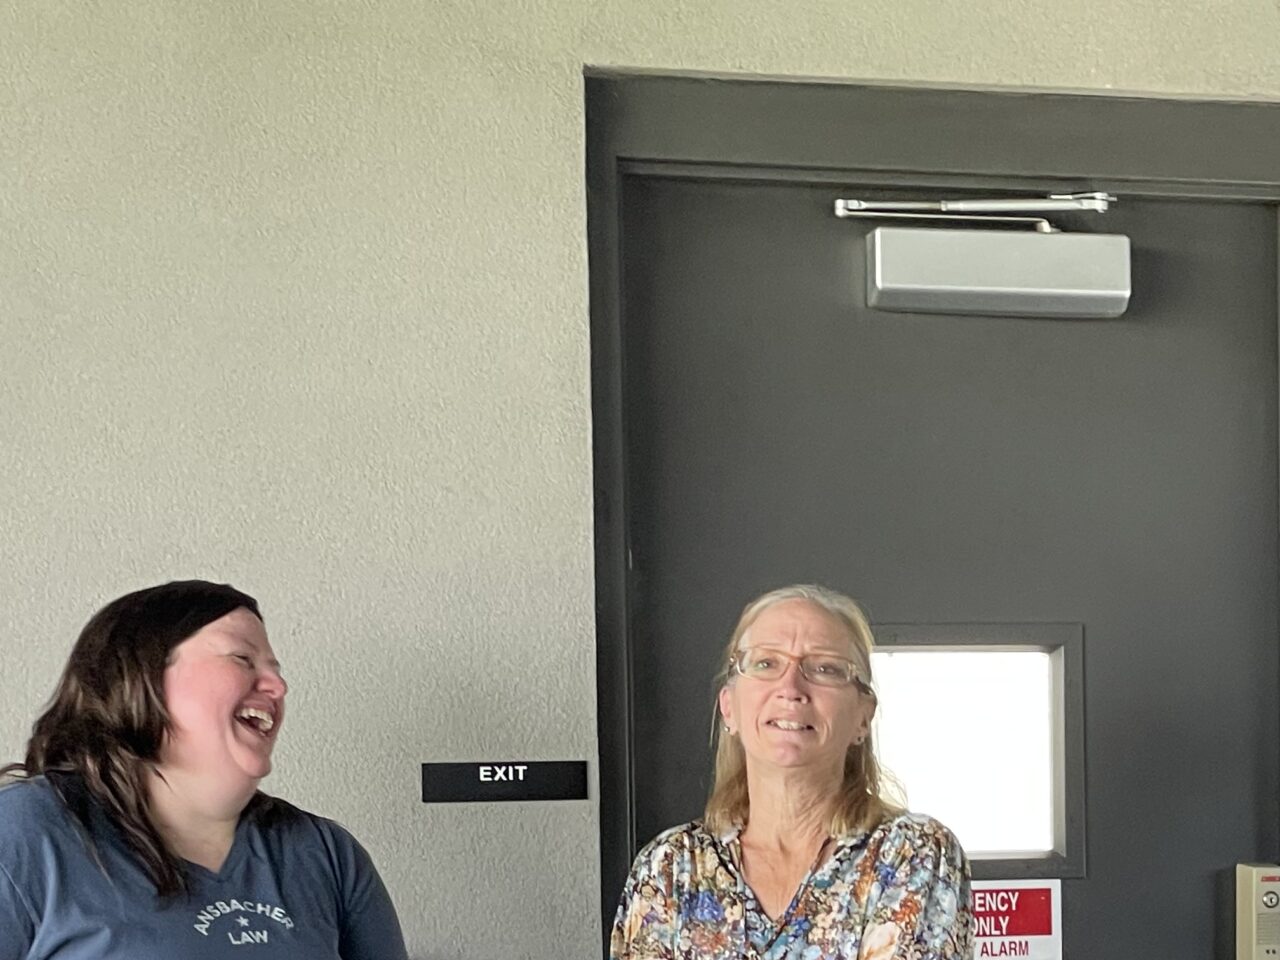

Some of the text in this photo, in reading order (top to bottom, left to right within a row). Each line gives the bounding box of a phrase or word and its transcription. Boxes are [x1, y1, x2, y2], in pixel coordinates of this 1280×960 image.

[479, 765, 528, 781] EXIT
[974, 891, 1019, 912] ENCY
[193, 898, 294, 936] ANSBACHER
[227, 930, 268, 945] LAW
[980, 940, 1029, 957] ALARM
